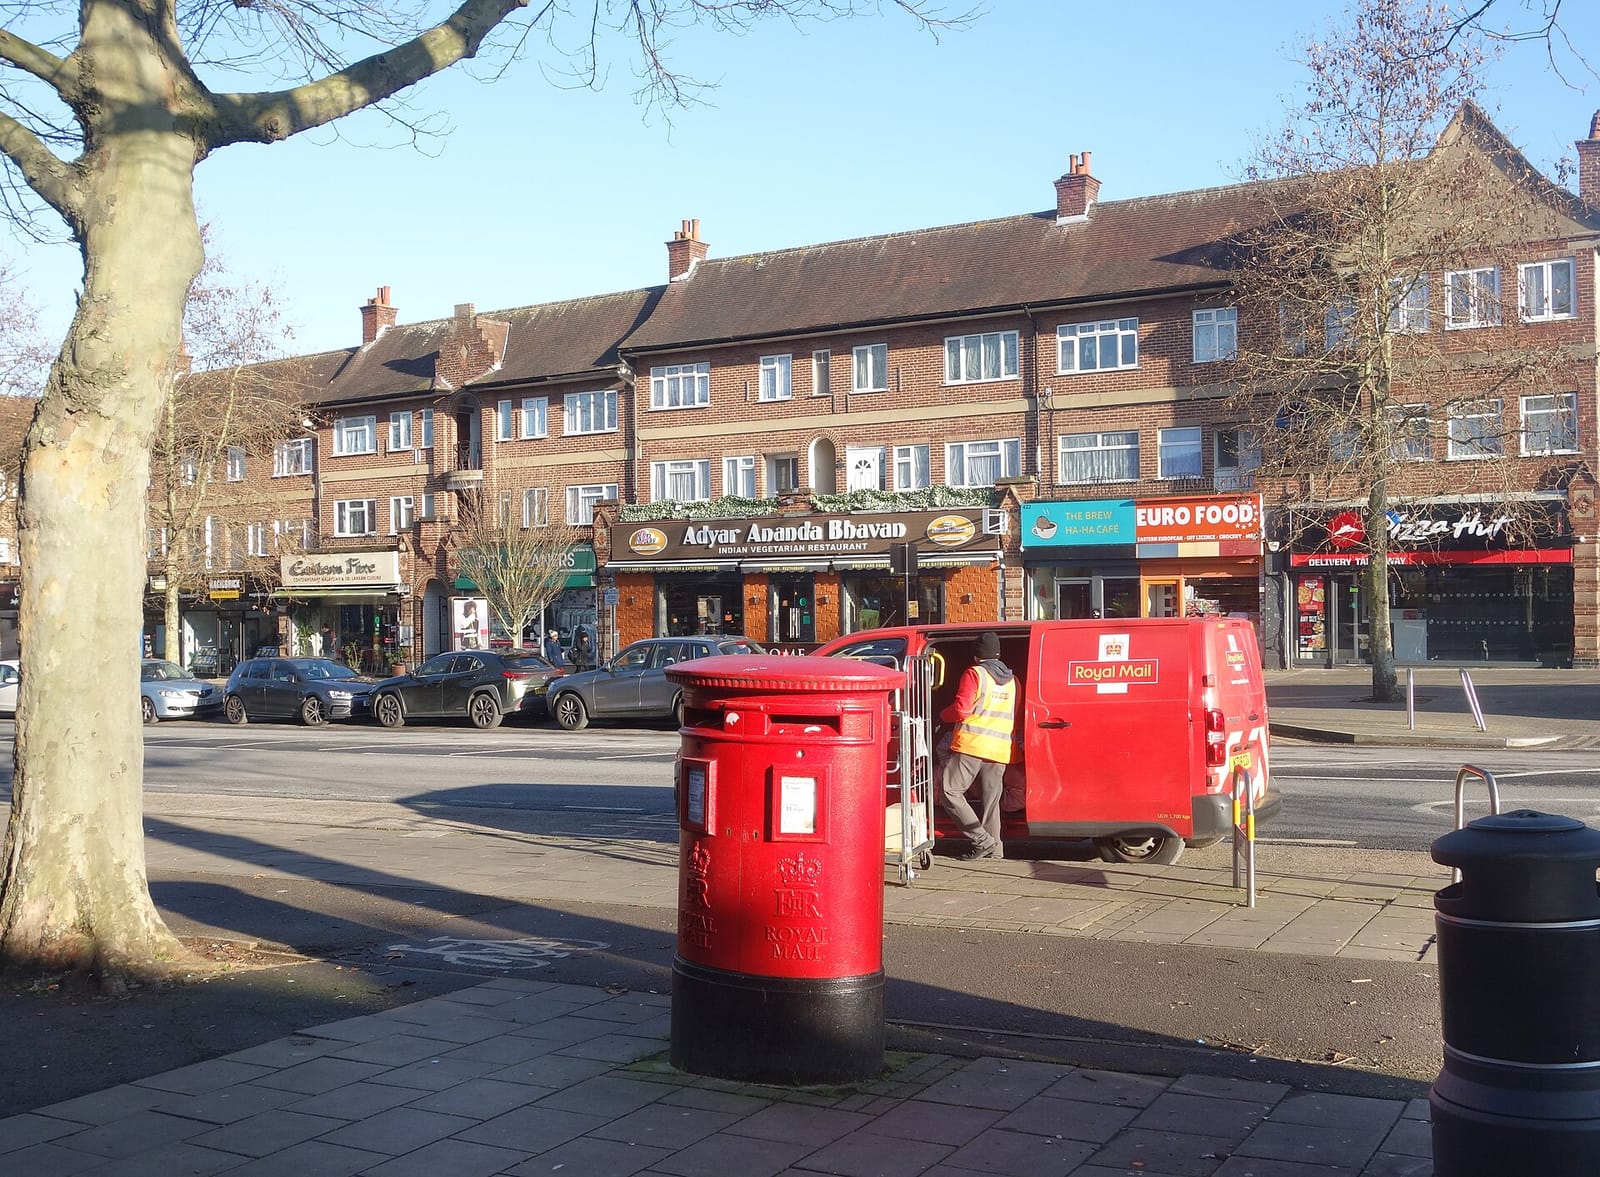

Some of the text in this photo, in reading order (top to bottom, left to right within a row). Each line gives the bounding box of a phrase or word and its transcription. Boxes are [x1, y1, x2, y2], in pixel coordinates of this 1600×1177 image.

[1065, 511, 1112, 521] THE BREW
[1136, 504, 1253, 527] EURO FOOD
[682, 525, 741, 549] Adyar
[746, 521, 823, 543] Ananda
[828, 519, 908, 540] Bhavan
[1452, 511, 1517, 539] Hut
[718, 542, 869, 554] INDIAN VEGETARIAN RESTAURANT
[1308, 556, 1406, 567] DELIVERY TAWAY
[1075, 663, 1152, 681] Royal Mail
[763, 926, 832, 944] ROYAL
[769, 943, 825, 961] MAIL
